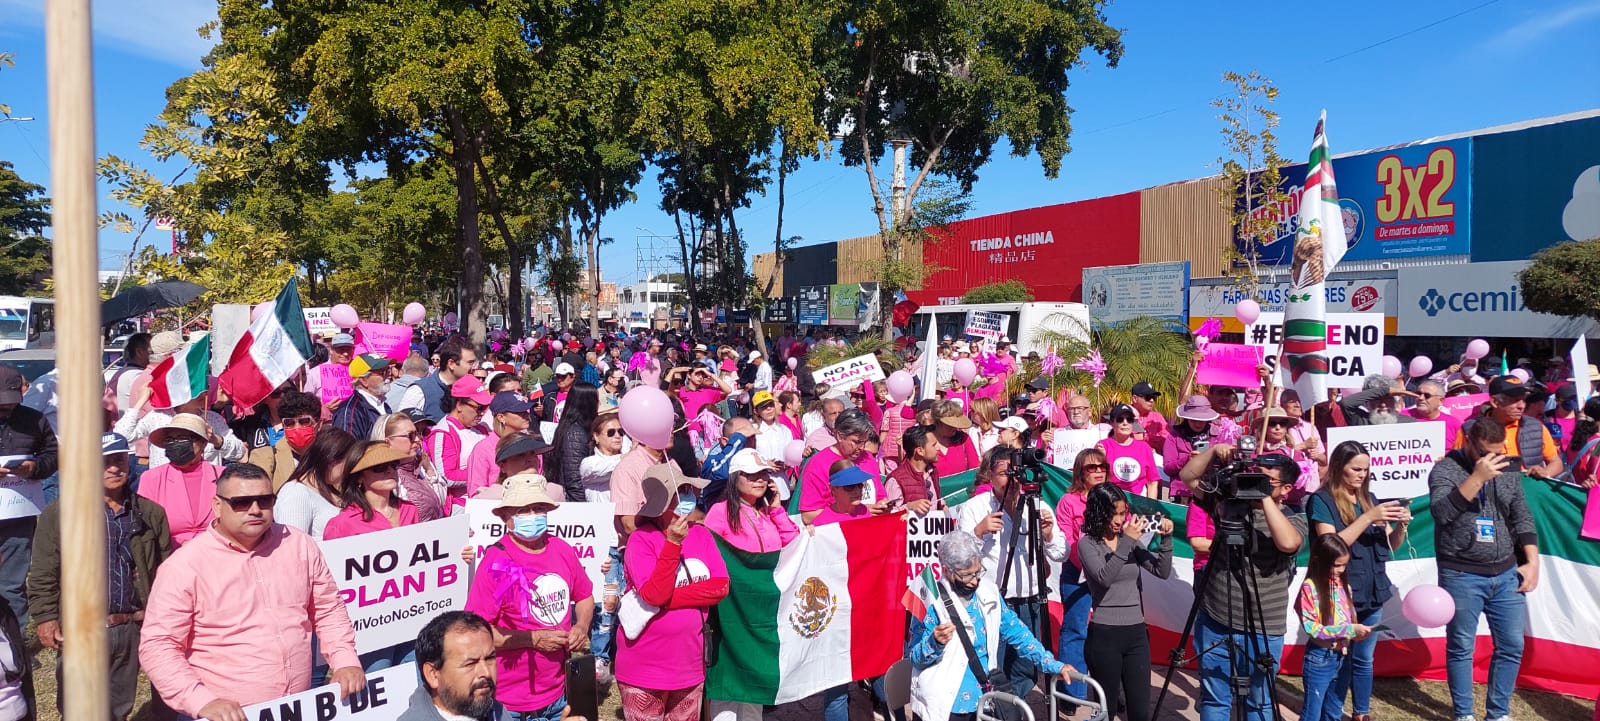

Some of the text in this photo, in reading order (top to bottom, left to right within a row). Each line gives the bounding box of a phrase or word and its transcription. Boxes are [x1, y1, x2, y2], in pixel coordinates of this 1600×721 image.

[1389, 227, 1411, 236] martes
[970, 231, 1055, 251] TIENDA CHINA
[989, 251, 1035, 264] 精品店
[938, 296, 963, 305] TIEN
[1449, 285, 1524, 312] cemi
[1252, 324, 1379, 345] #EENO
[823, 360, 868, 378] NO AL
[1328, 355, 1365, 376] CA
[821, 368, 860, 384] PLAN
[1362, 438, 1431, 451] ENVENIDA
[1371, 452, 1433, 467] MA PIÑA
[482, 524, 596, 538] “BIENIDA
[908, 540, 941, 558] MOS
[345, 549, 399, 581] NO
[409, 540, 449, 567] AL
[338, 563, 458, 608] PLAN B
[351, 597, 452, 631] MiVotoNoSeToca
[257, 676, 388, 721] AN B DE
